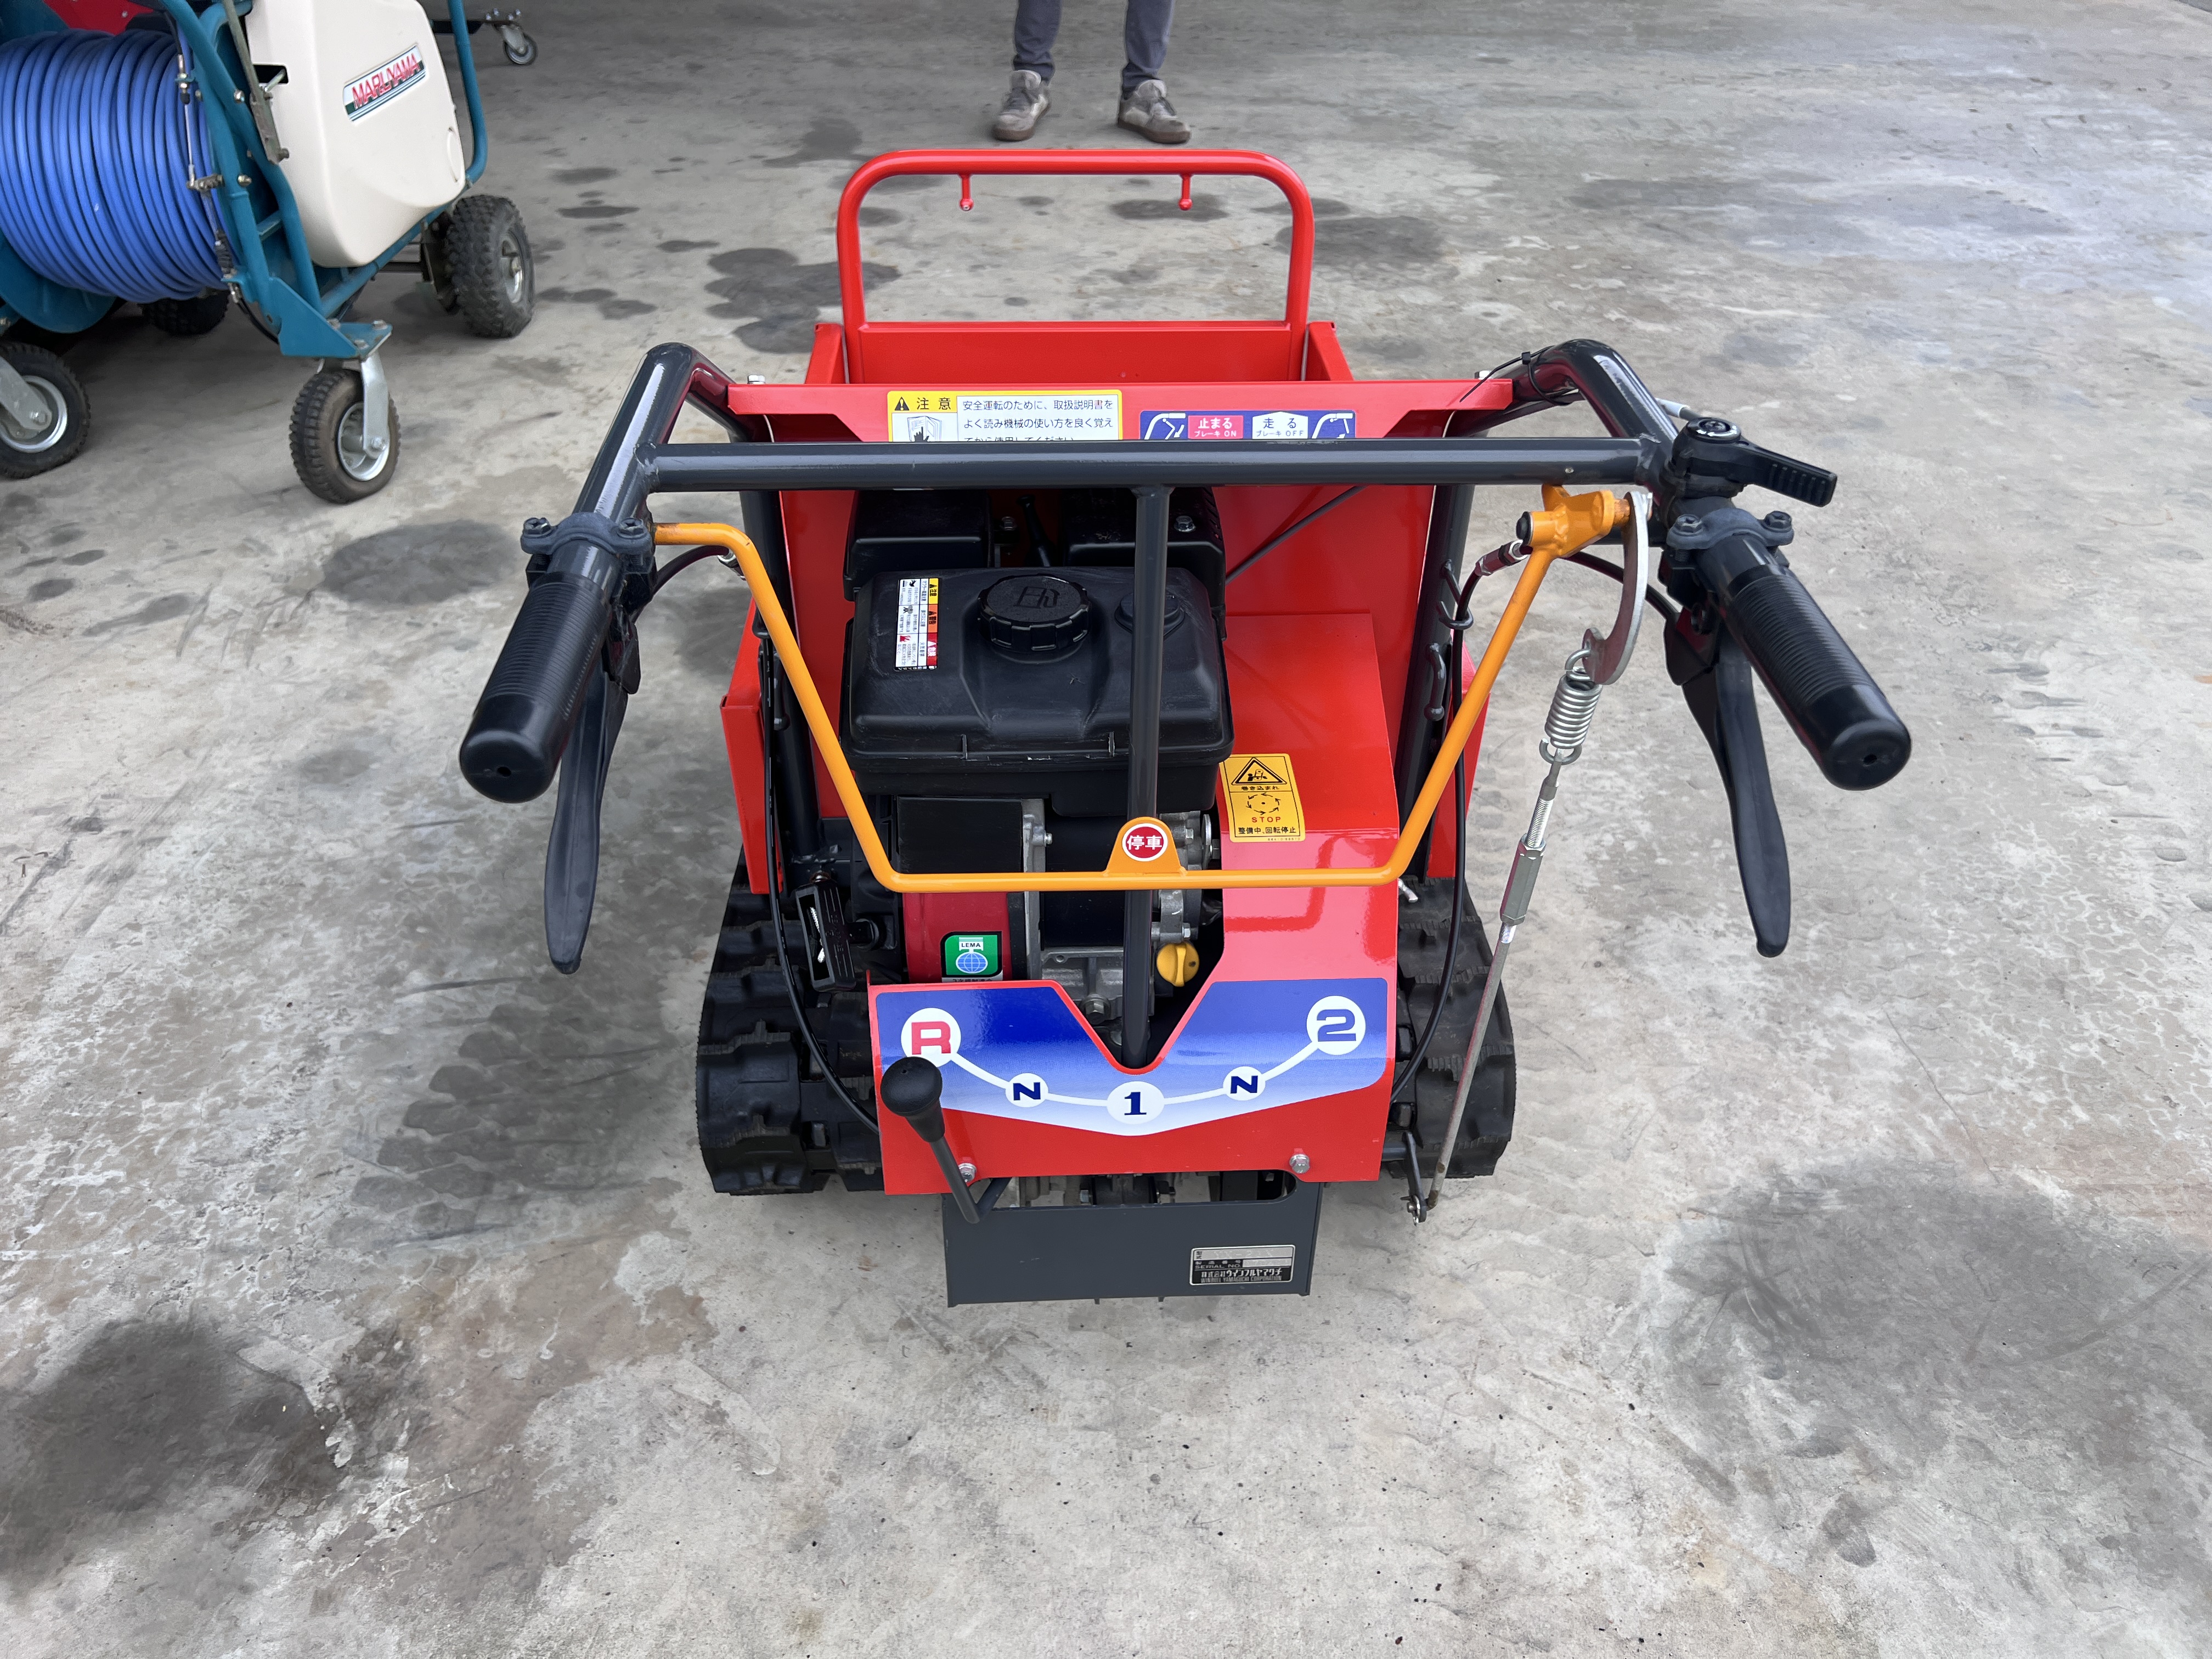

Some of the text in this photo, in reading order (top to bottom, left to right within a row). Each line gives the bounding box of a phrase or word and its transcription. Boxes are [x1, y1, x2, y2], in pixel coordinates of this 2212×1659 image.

[351, 53, 421, 110] MARUYAMA
[916, 397, 951, 410] 注意
[963, 399, 1113, 411] 安全運転のために、取扱説明書を
[963, 417, 1114, 429] よく読み機械の使い方を良く覚え
[1198, 417, 1233, 430] 止まる
[1263, 417, 1297, 430] 走る
[1126, 834, 1163, 850] 停車
[1316, 1008, 1357, 1042] 2
[911, 1020, 952, 1056] R
[1013, 1081, 1041, 1101] N
[1229, 1075, 1259, 1094] N
[1124, 1091, 1147, 1116] 1
